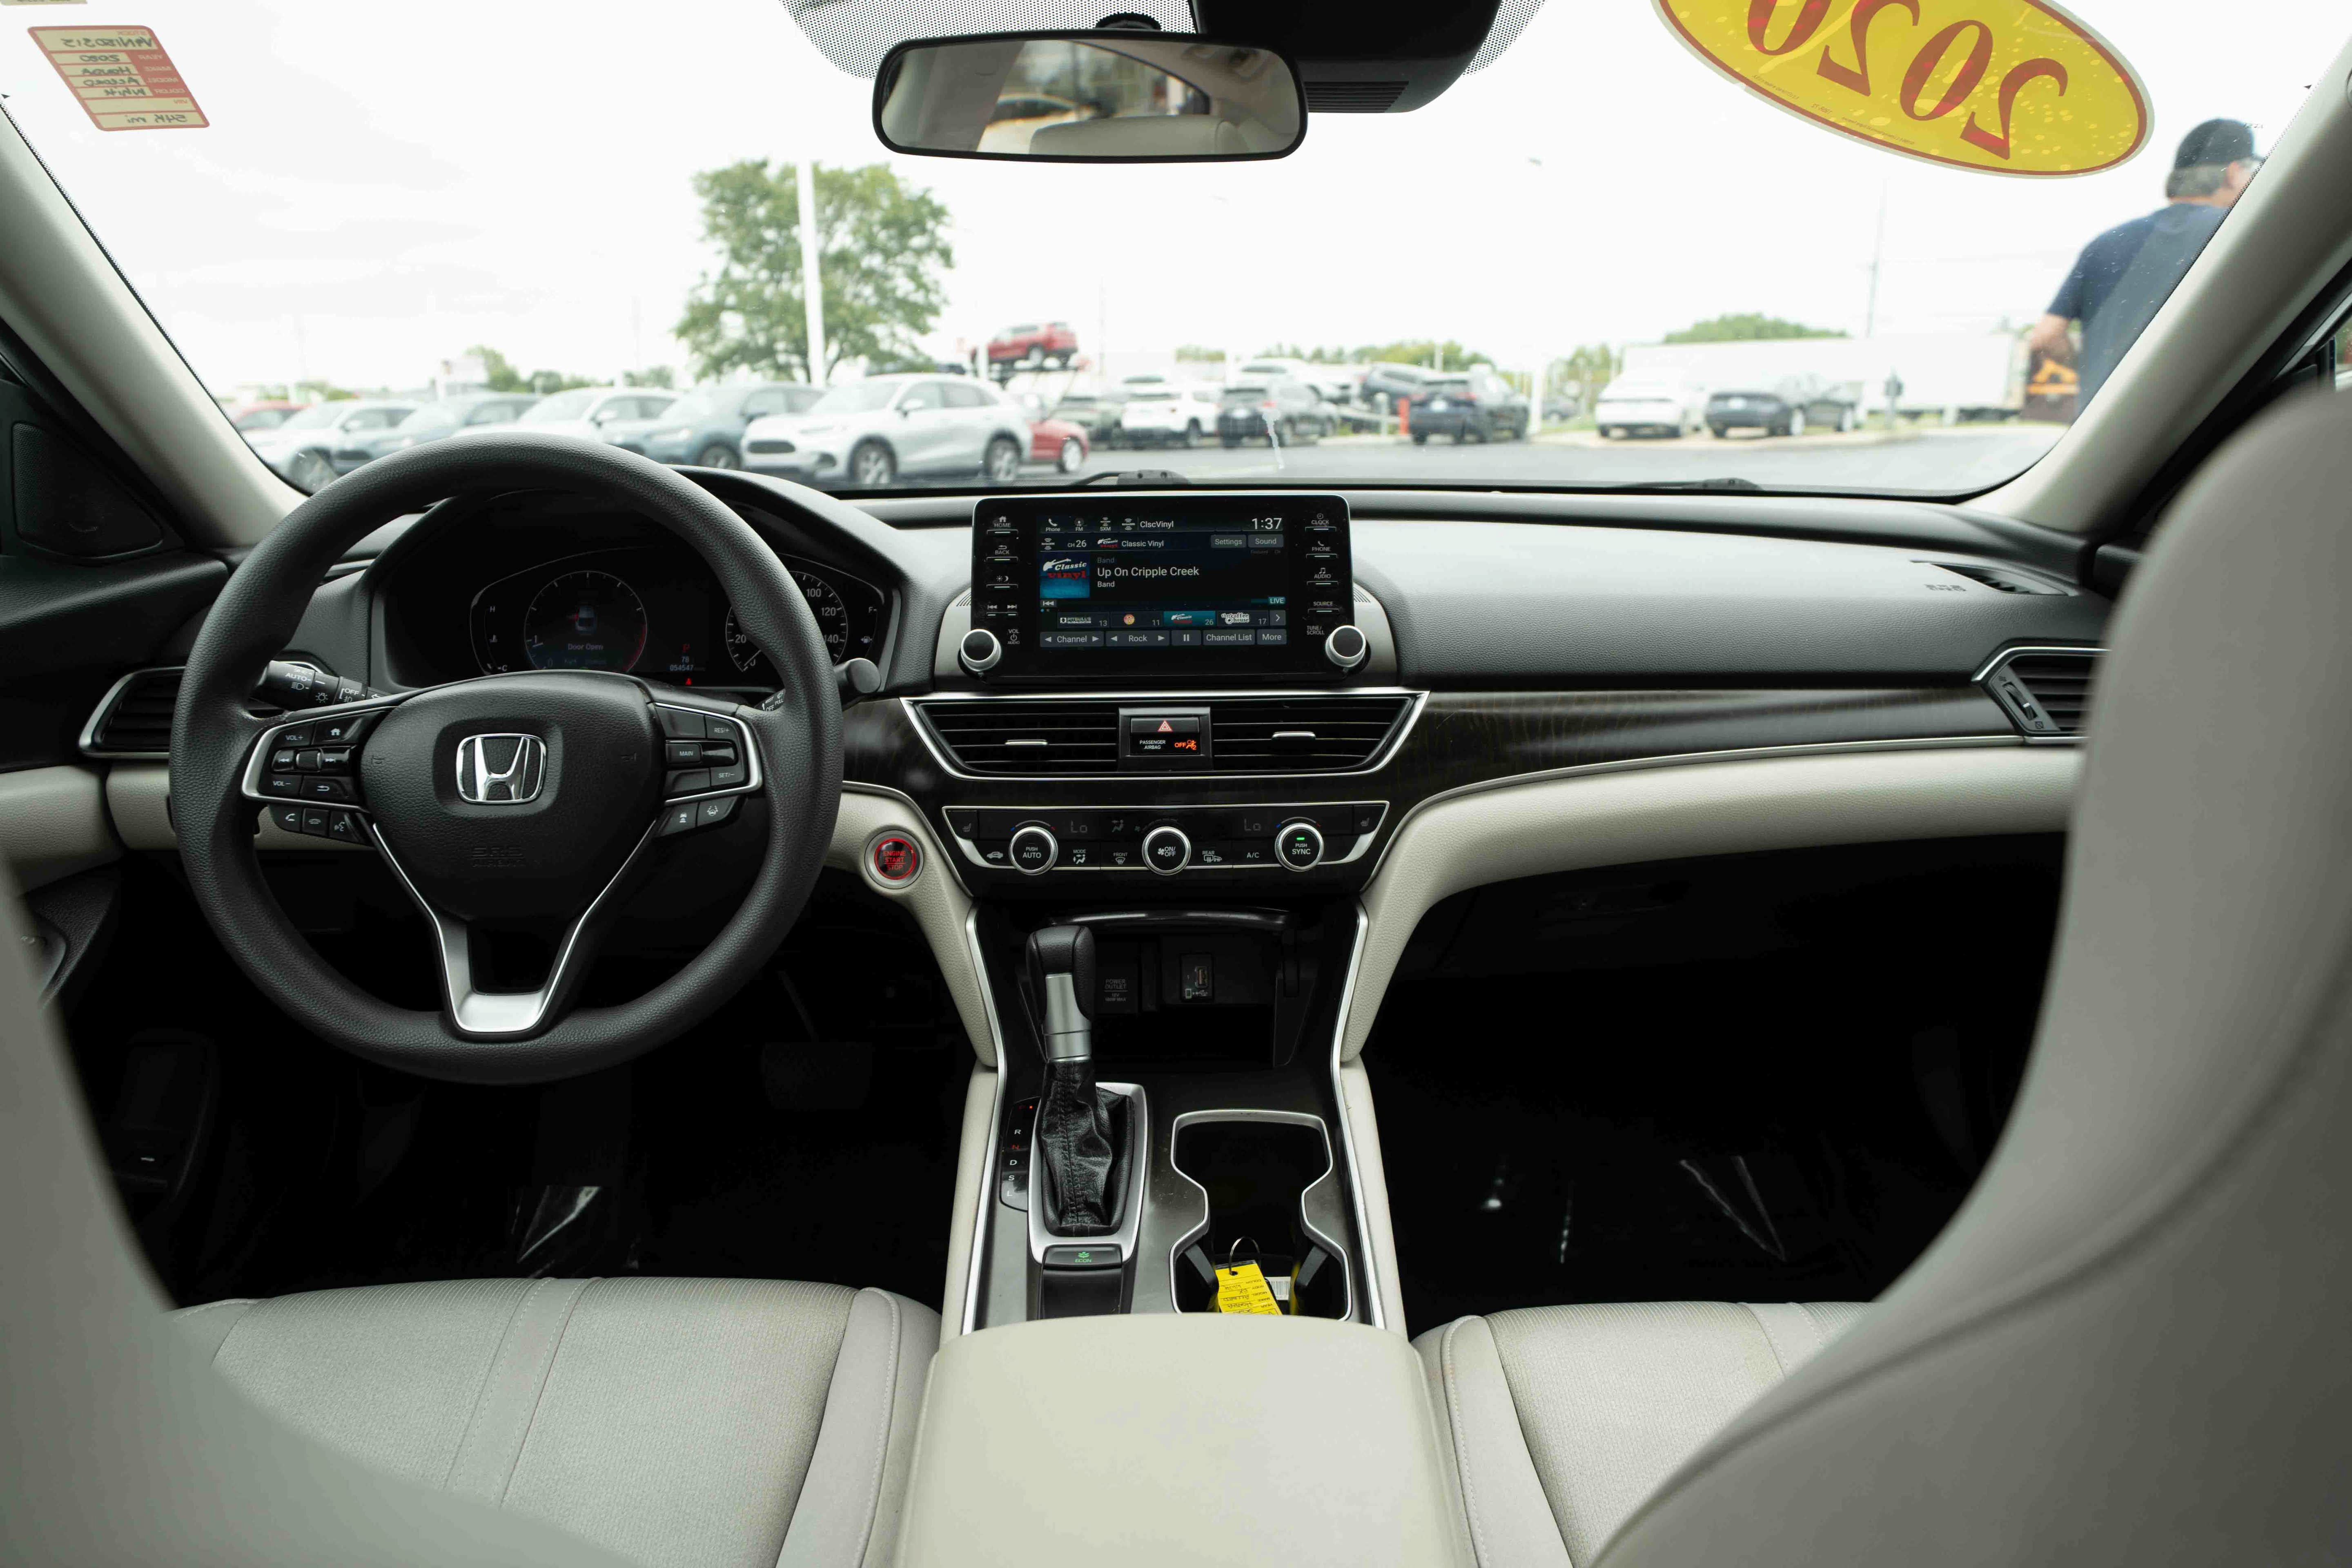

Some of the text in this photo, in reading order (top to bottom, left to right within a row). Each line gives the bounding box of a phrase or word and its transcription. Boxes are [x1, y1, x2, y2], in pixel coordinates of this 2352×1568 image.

[1252, 518, 1282, 530] 1:37
[1147, 540, 1164, 548] Vinyl
[1054, 561, 1087, 571] Classic
[1047, 570, 1087, 581] vinyl
[1097, 566, 1200, 578] Up On Cripple Creek
[806, 588, 822, 598] 100
[821, 607, 836, 616] 120
[735, 635, 746, 644] 20
[585, 644, 604, 652] Open
[285, 673, 307, 681] AUTO
[1071, 821, 1088, 833] Lo
[1244, 818, 1261, 831] Lo
